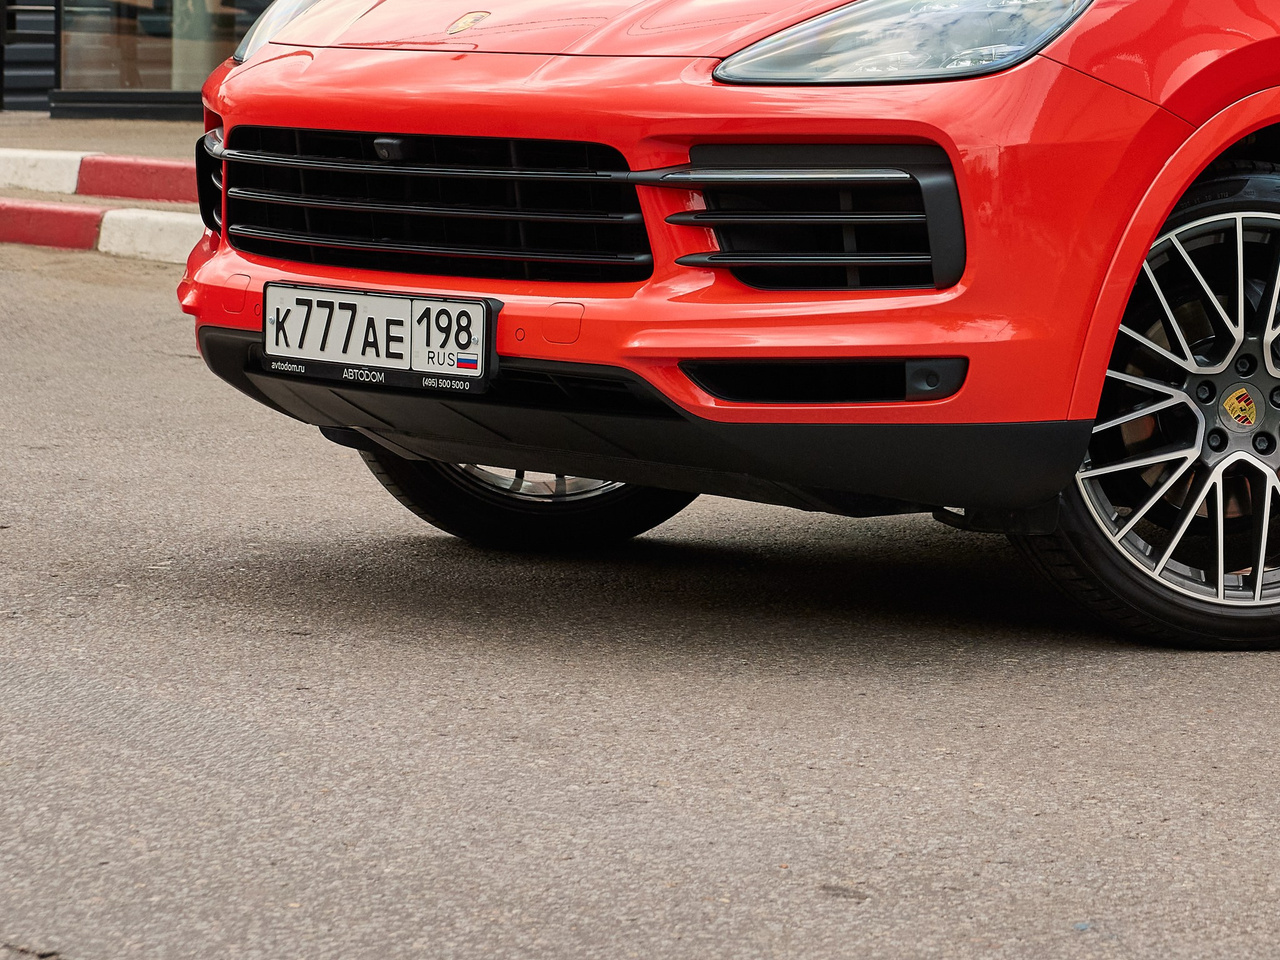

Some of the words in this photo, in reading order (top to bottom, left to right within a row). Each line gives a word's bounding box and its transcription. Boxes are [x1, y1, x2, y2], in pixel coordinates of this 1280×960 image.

[275, 297, 404, 360] K777AE
[416, 306, 472, 350] 198
[271, 361, 305, 373] avtodom.ru
[427, 350, 455, 367] RUS
[438, 379, 451, 388] 500
[452, 380, 465, 389] 500
[465, 382, 470, 390] 0
